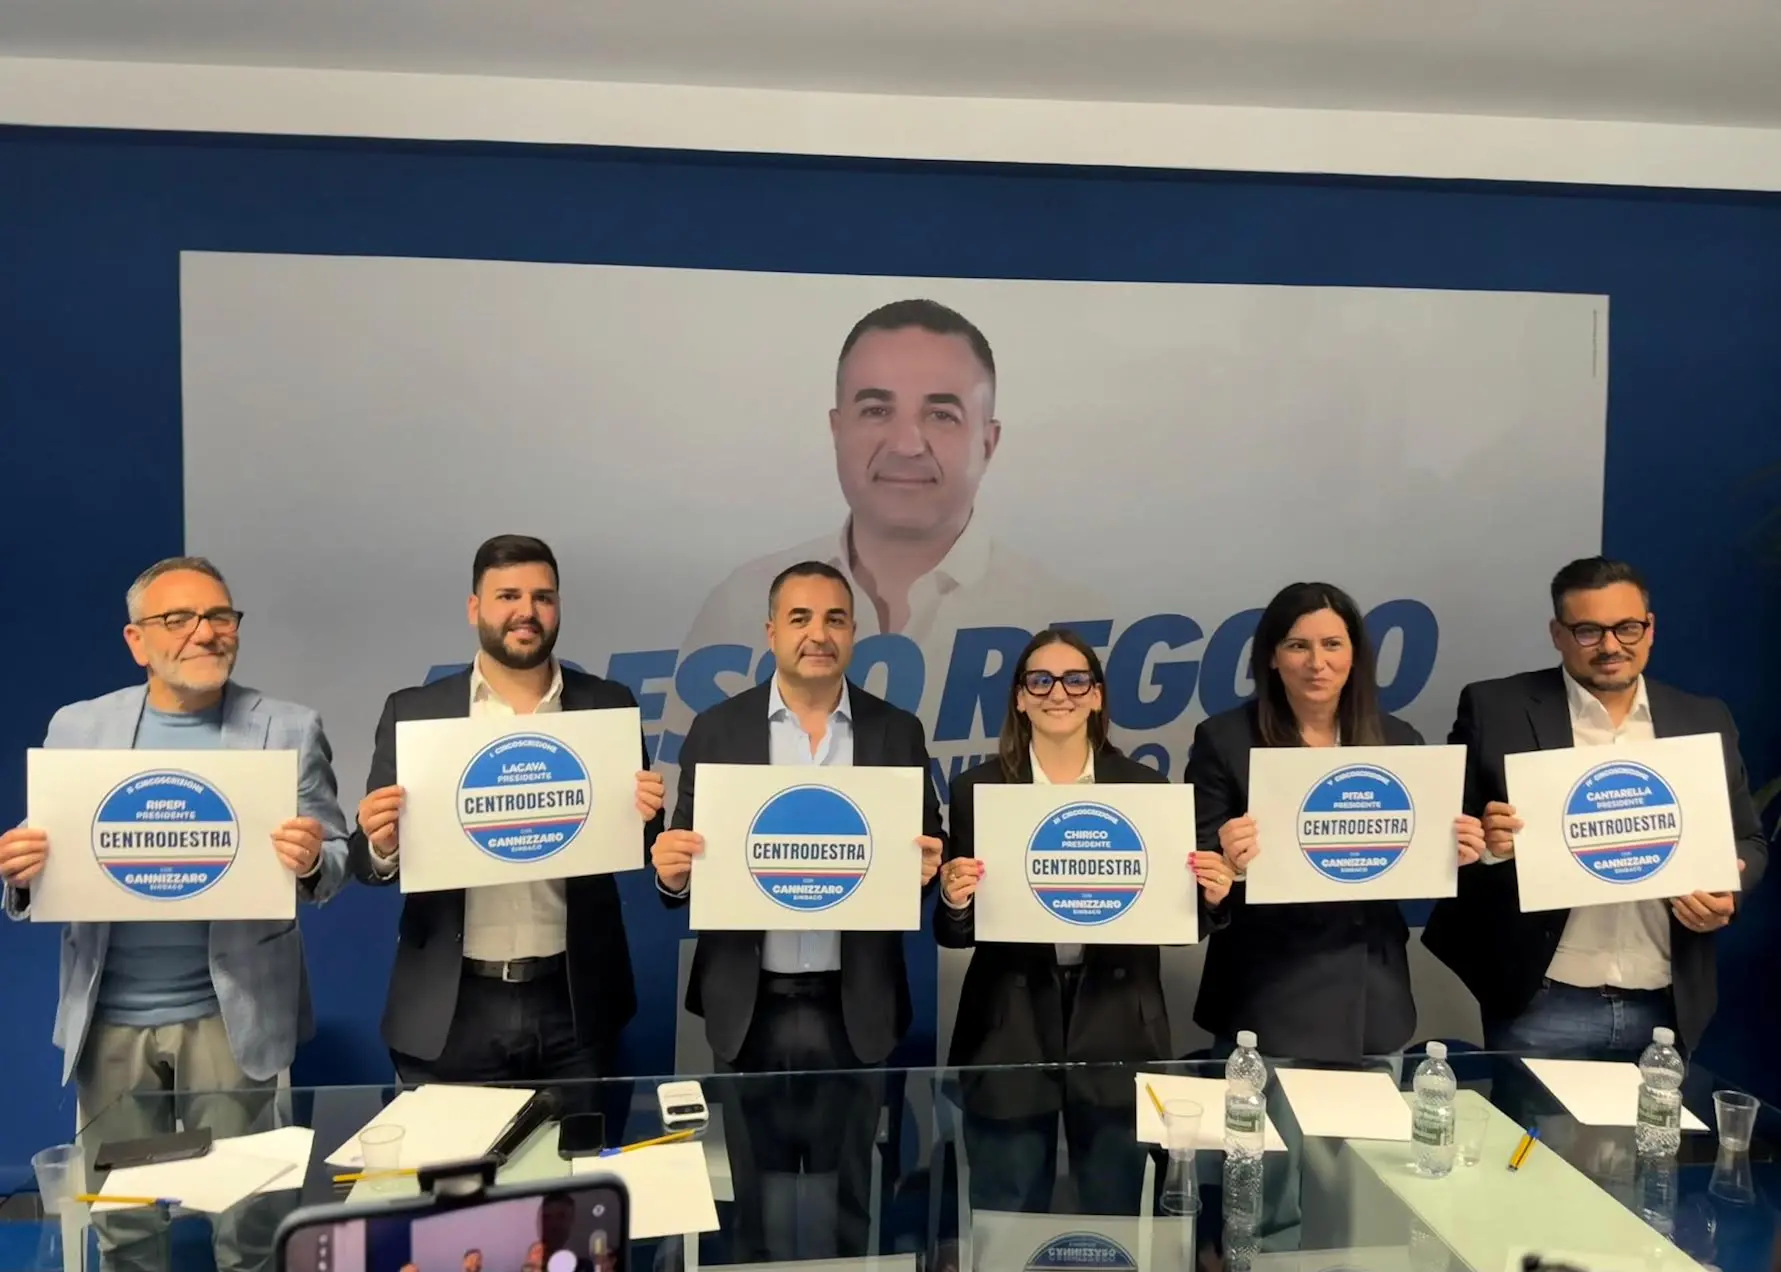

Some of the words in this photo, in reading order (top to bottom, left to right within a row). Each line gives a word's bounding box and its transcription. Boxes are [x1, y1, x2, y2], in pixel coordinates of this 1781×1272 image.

[502, 762, 547, 773] LACAVA
[497, 772, 552, 783] PRESIDENTE
[1342, 791, 1374, 800] PITASI
[1586, 786, 1653, 801] CANTARELLA
[146, 799, 187, 811] RIPEPI
[465, 789, 585, 814] CENTRODESTRA
[1596, 798, 1644, 809] PRESIDENTE
[136, 811, 196, 820] PRESIDENTE
[1304, 819, 1408, 835] CENTRODESTRA
[1570, 813, 1676, 839] CENTRODESTRA
[100, 831, 232, 848] CENTRODESTRA
[488, 832, 564, 848] CANNIZZARO
[1064, 830, 1108, 839] CHIRICO
[753, 843, 865, 860] CENTRODESTRA
[1032, 859, 1141, 875] CENTRODESTRA
[1321, 857, 1387, 868] CANNIZZARO
[1594, 854, 1660, 870] CANNIZZARO
[125, 873, 208, 885] CANNIZZARO
[772, 885, 843, 894] CANNIZZARO
[1052, 899, 1121, 909] CANNIZZARO
